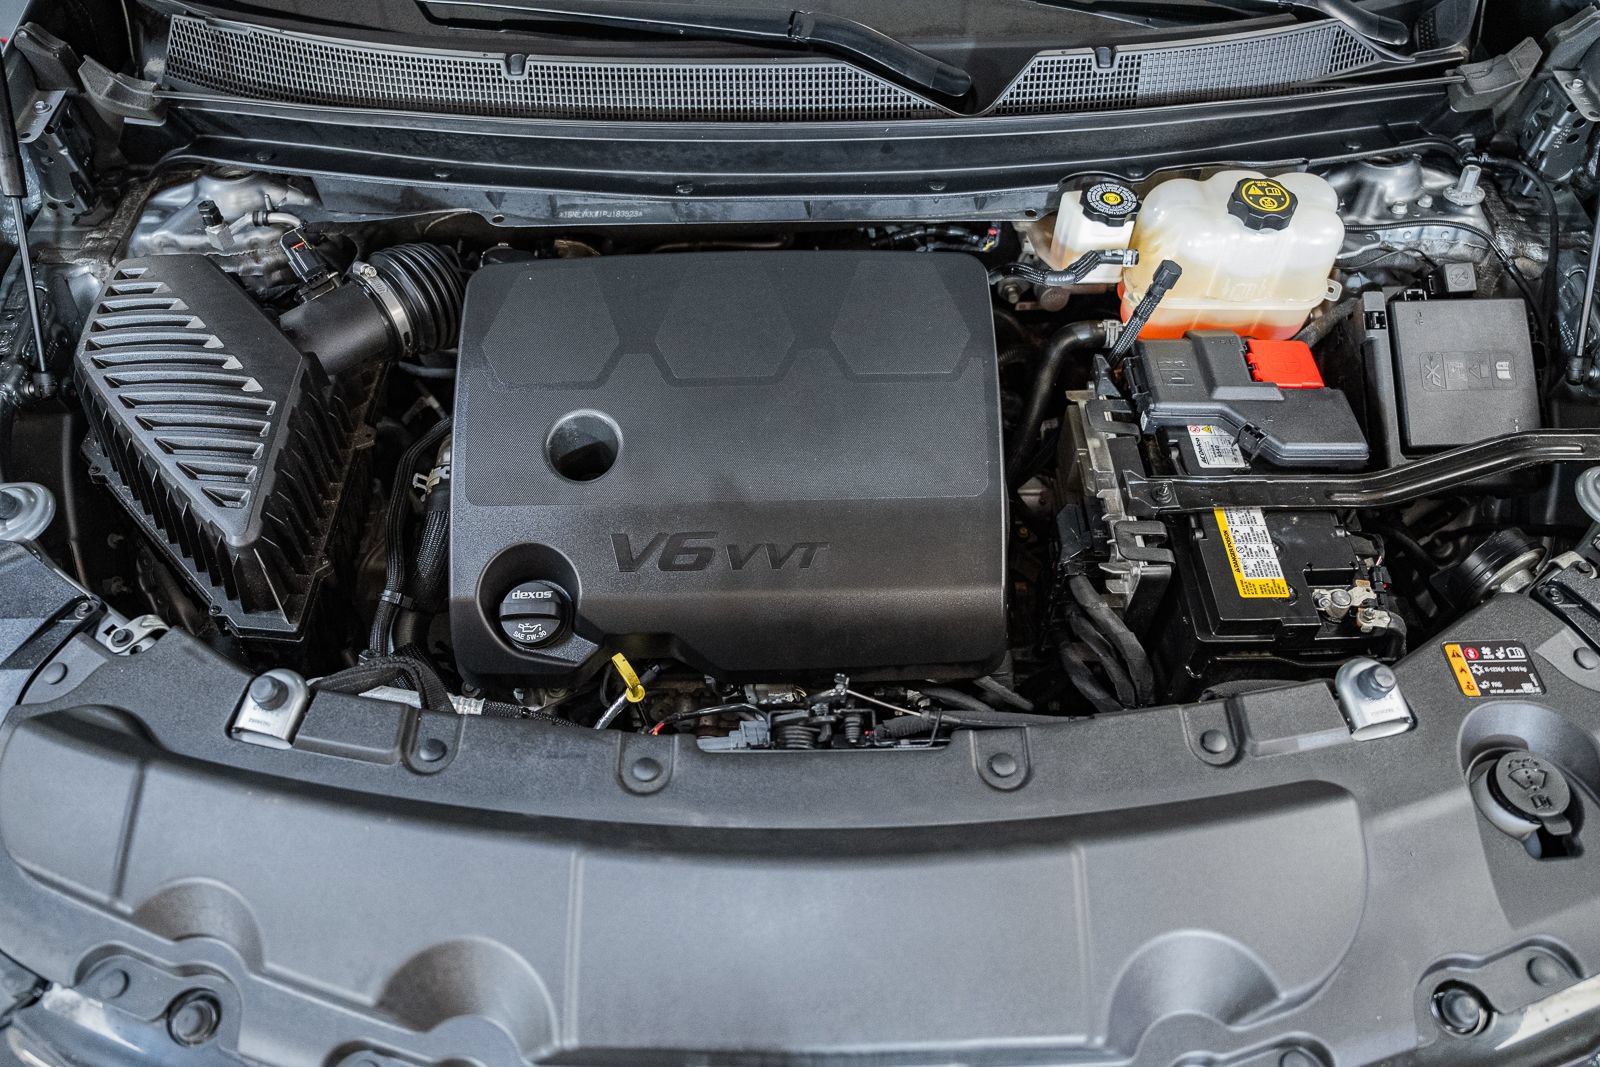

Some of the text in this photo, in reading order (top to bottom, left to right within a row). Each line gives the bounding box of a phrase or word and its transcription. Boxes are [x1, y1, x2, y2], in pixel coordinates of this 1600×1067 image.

[610, 531, 830, 573] V6 VVT
[511, 590, 554, 600] dexos
[513, 630, 547, 641] SAE 5W-30
